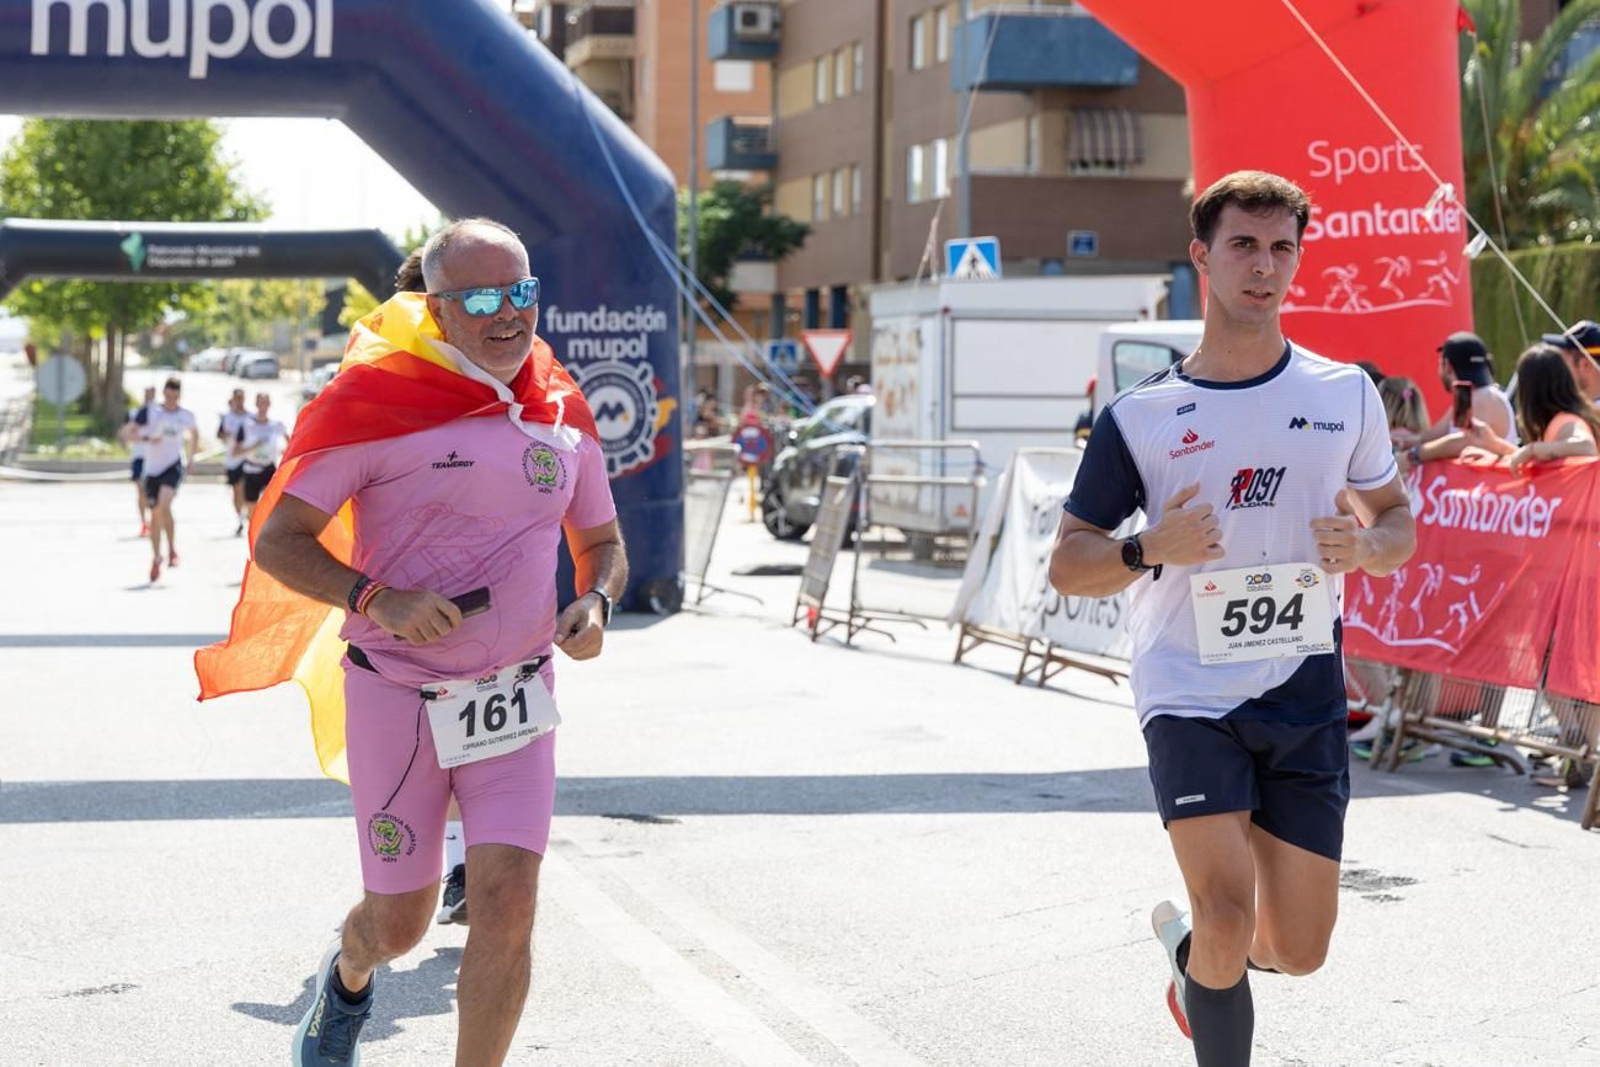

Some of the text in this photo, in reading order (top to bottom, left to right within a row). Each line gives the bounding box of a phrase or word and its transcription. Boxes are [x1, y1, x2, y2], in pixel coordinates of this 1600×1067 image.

[30, 0, 334, 79] mupol
[1307, 139, 1423, 184] Sports
[1301, 199, 1461, 241] Santander
[545, 304, 667, 333] fundación
[567, 331, 648, 364] mupol
[1313, 420, 1345, 433] mupol
[431, 460, 475, 469] TEAMERGY
[1169, 439, 1216, 460] Santander
[1423, 475, 1562, 538] Santander
[1220, 592, 1304, 637] 594
[1227, 640, 1243, 650] JUAN
[1267, 635, 1304, 647] CASTELLANO
[458, 687, 529, 738] 161
[462, 739, 489, 751] CIPRIANO
[488, 731, 517, 746] GUTIERREZ
[517, 726, 539, 738] ARENAS
